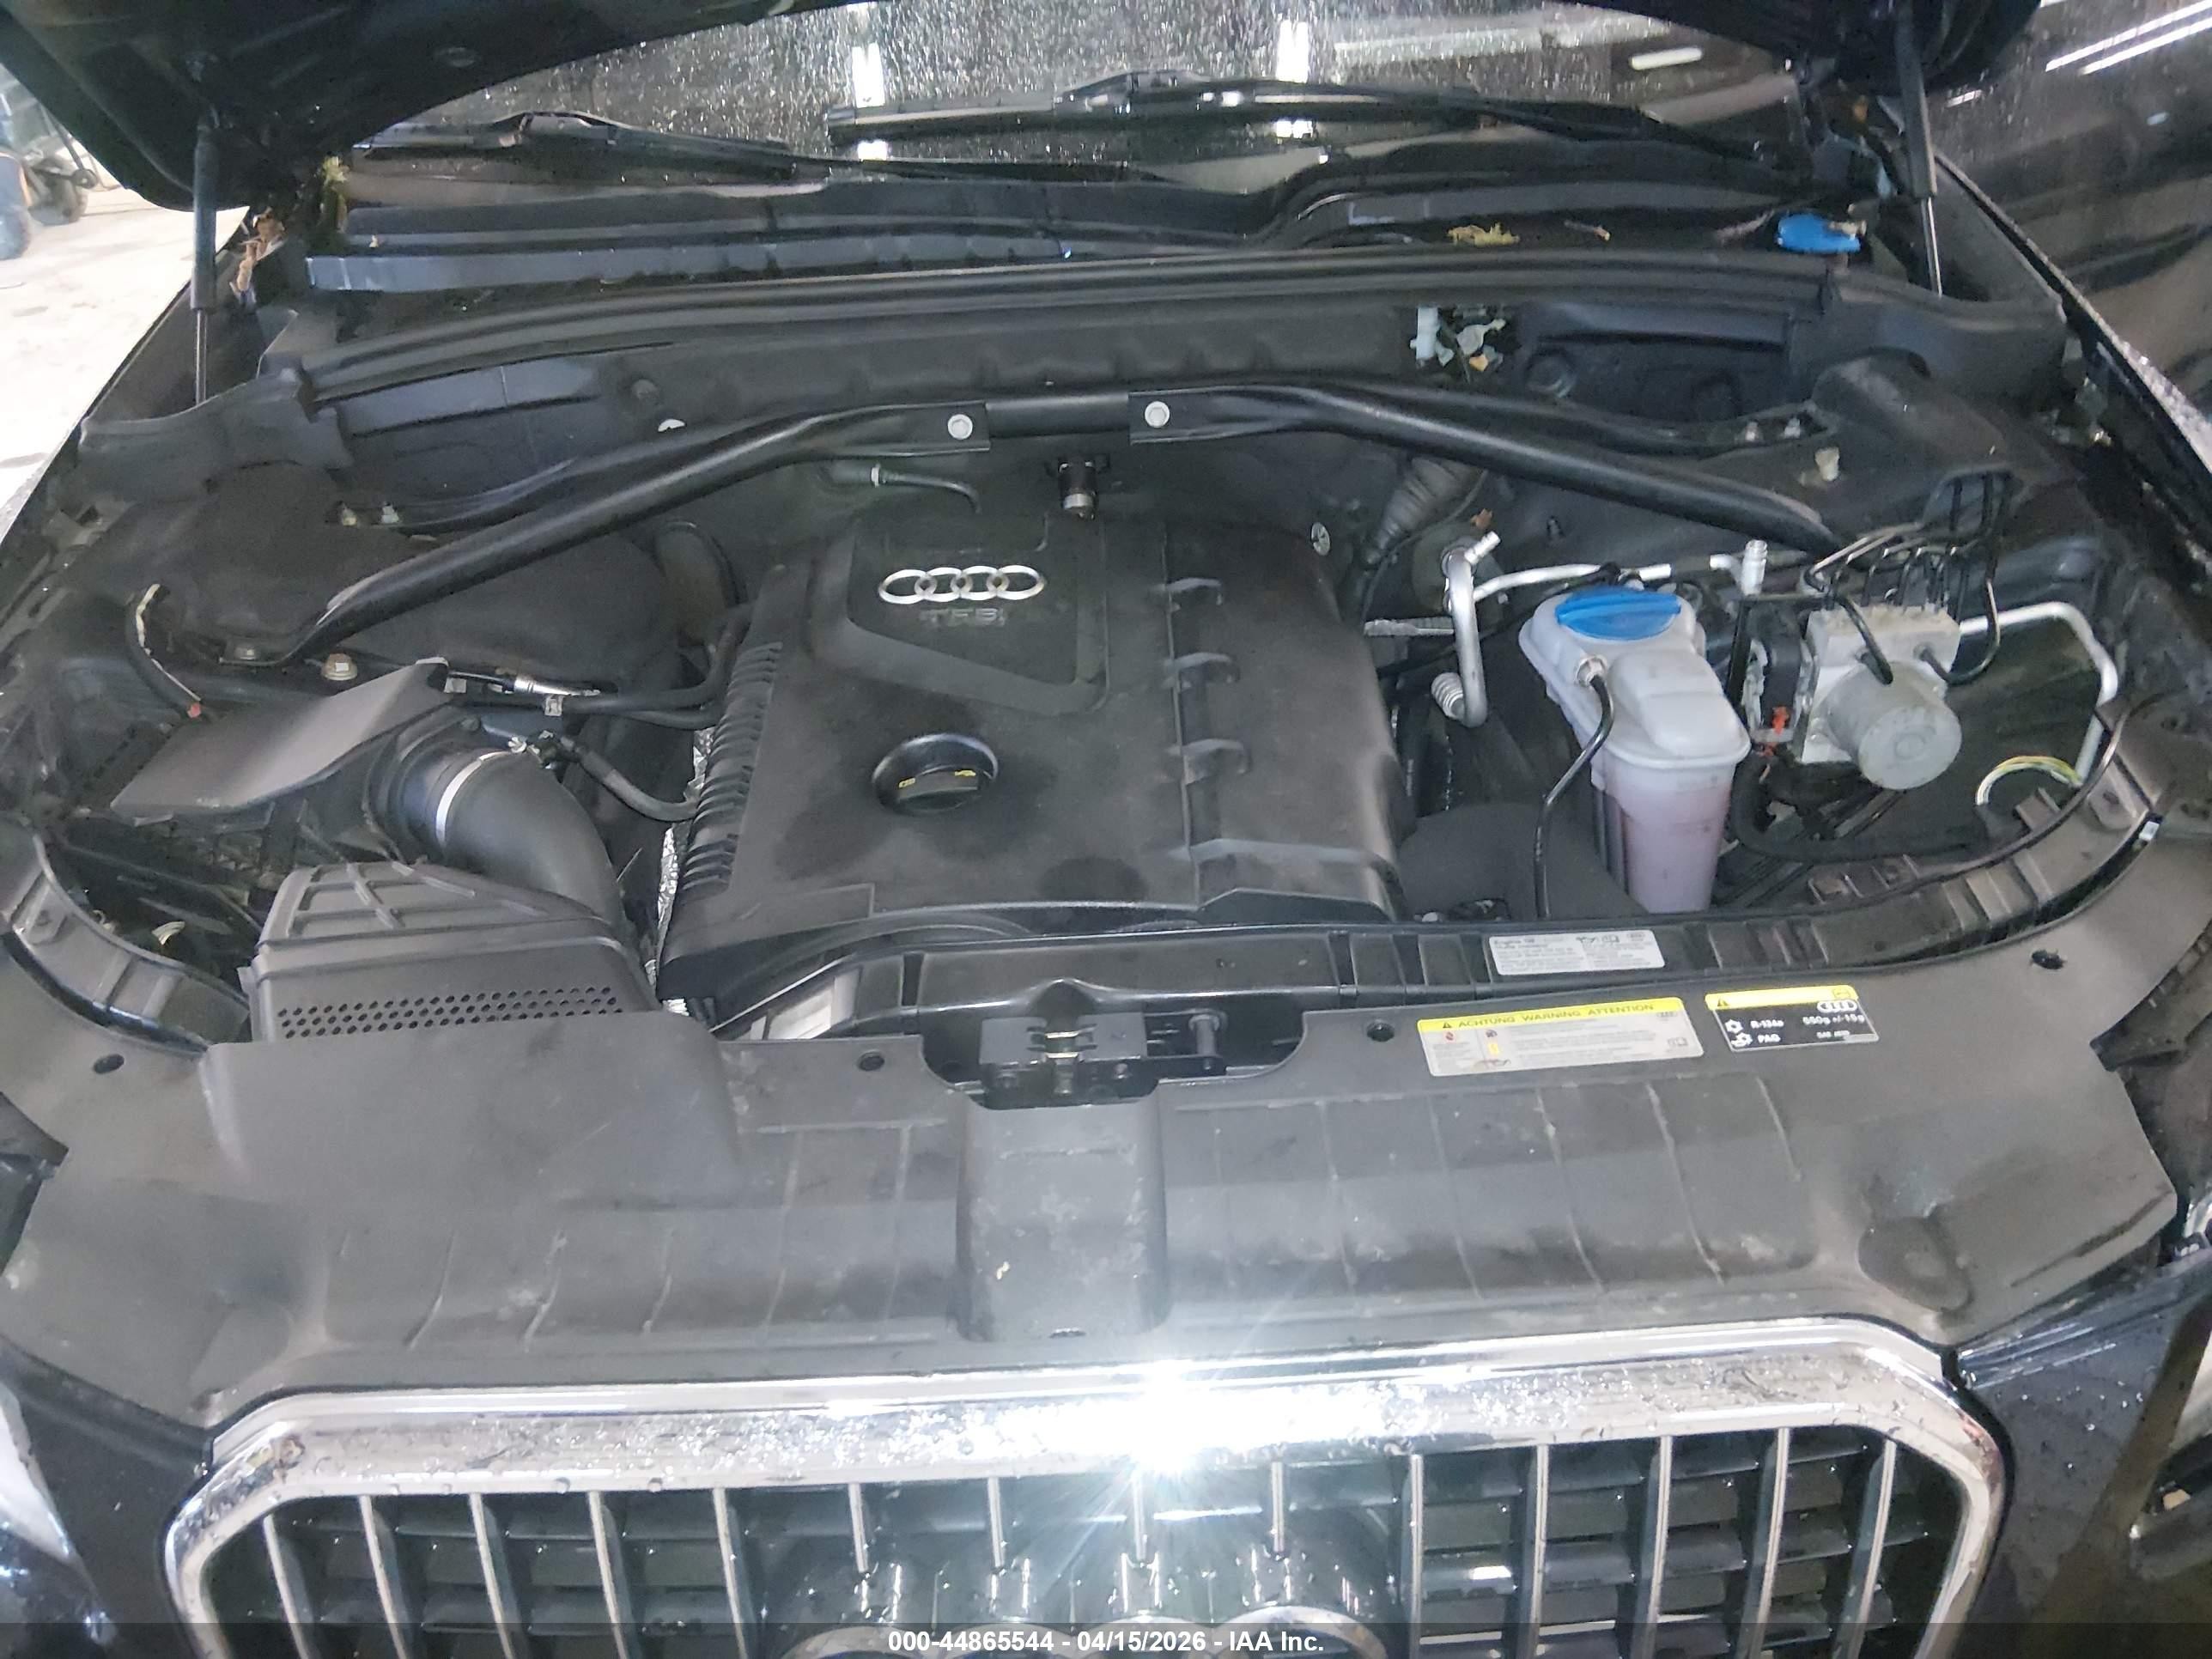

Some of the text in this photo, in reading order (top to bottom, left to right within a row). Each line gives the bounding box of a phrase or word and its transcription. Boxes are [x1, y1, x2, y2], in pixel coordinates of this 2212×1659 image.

[1458, 1004, 1654, 1028] ACHTUNG WARNING ATTENTION
